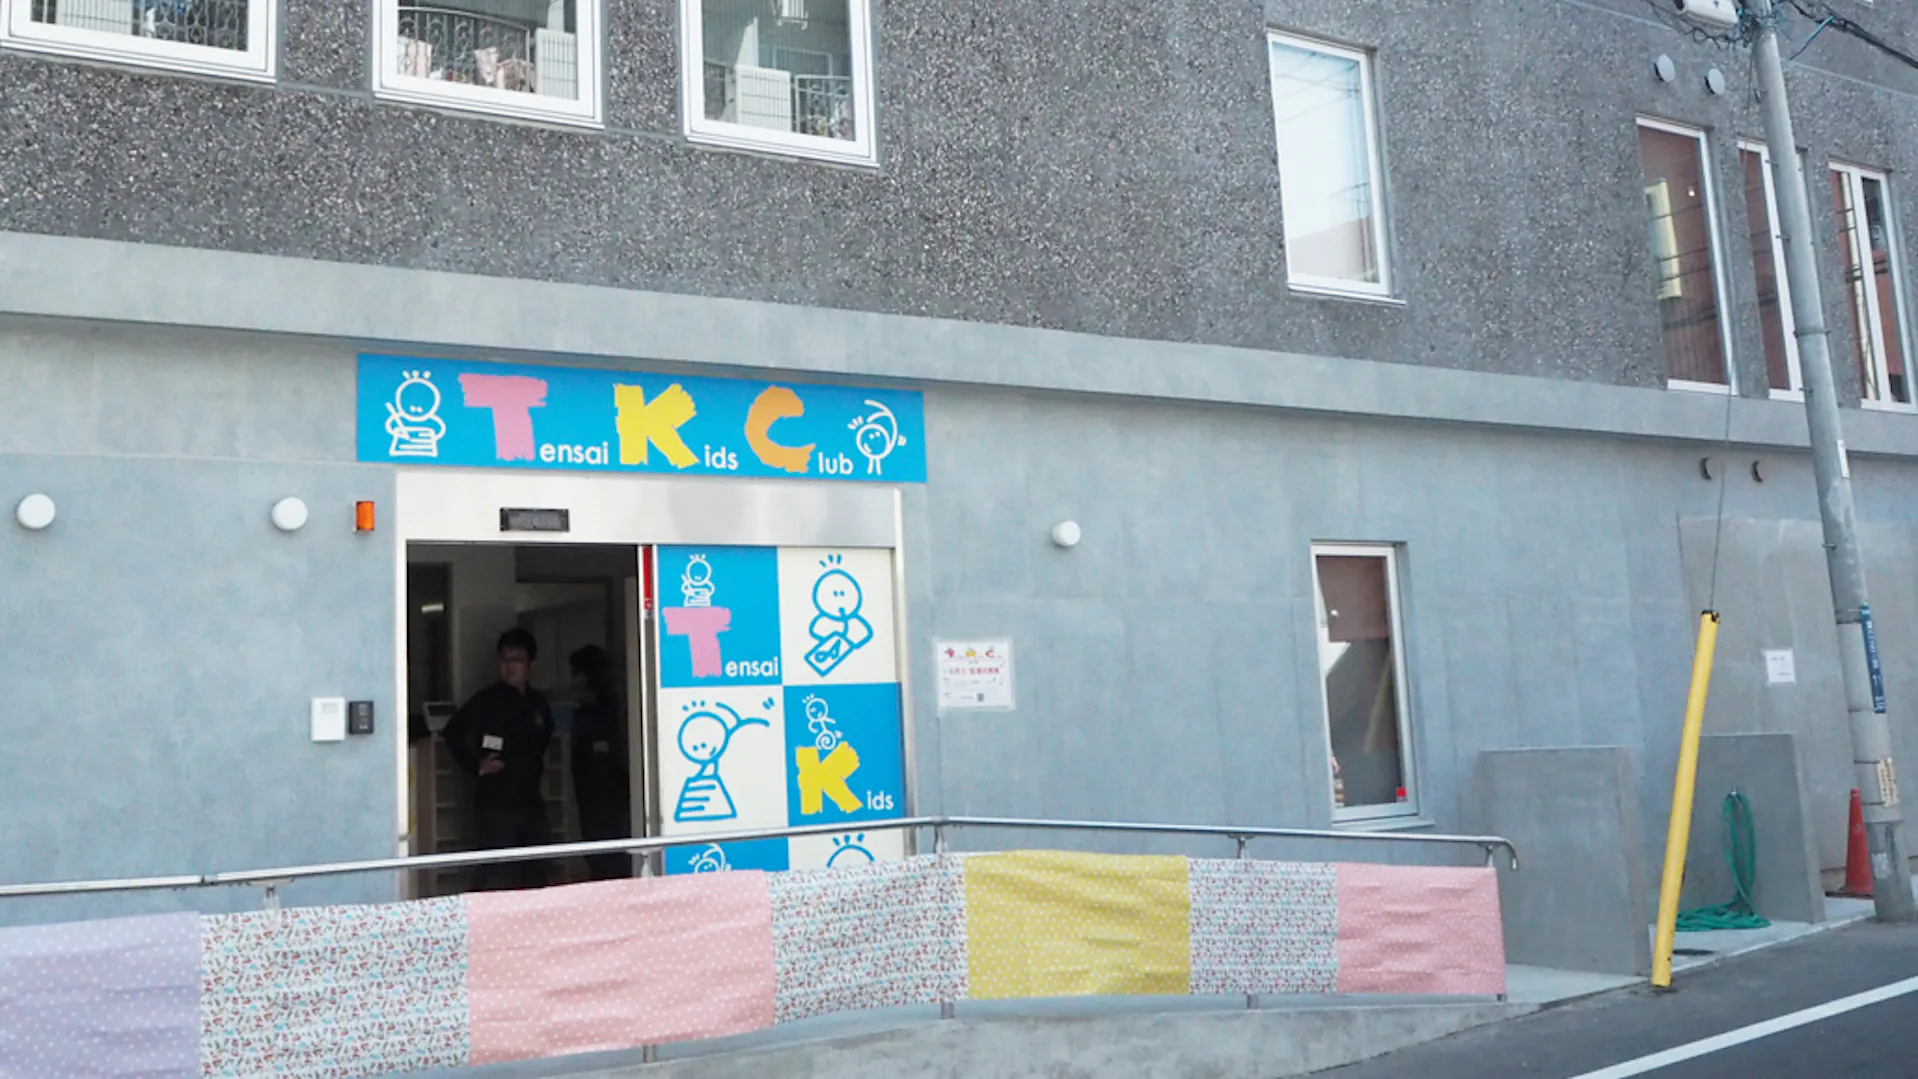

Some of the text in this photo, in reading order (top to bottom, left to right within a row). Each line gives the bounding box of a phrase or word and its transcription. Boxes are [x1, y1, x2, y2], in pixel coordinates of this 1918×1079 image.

[458, 373, 854, 475] Tensai Kids Club
[662, 606, 780, 678] Tensai
[795, 741, 895, 815] Kids
